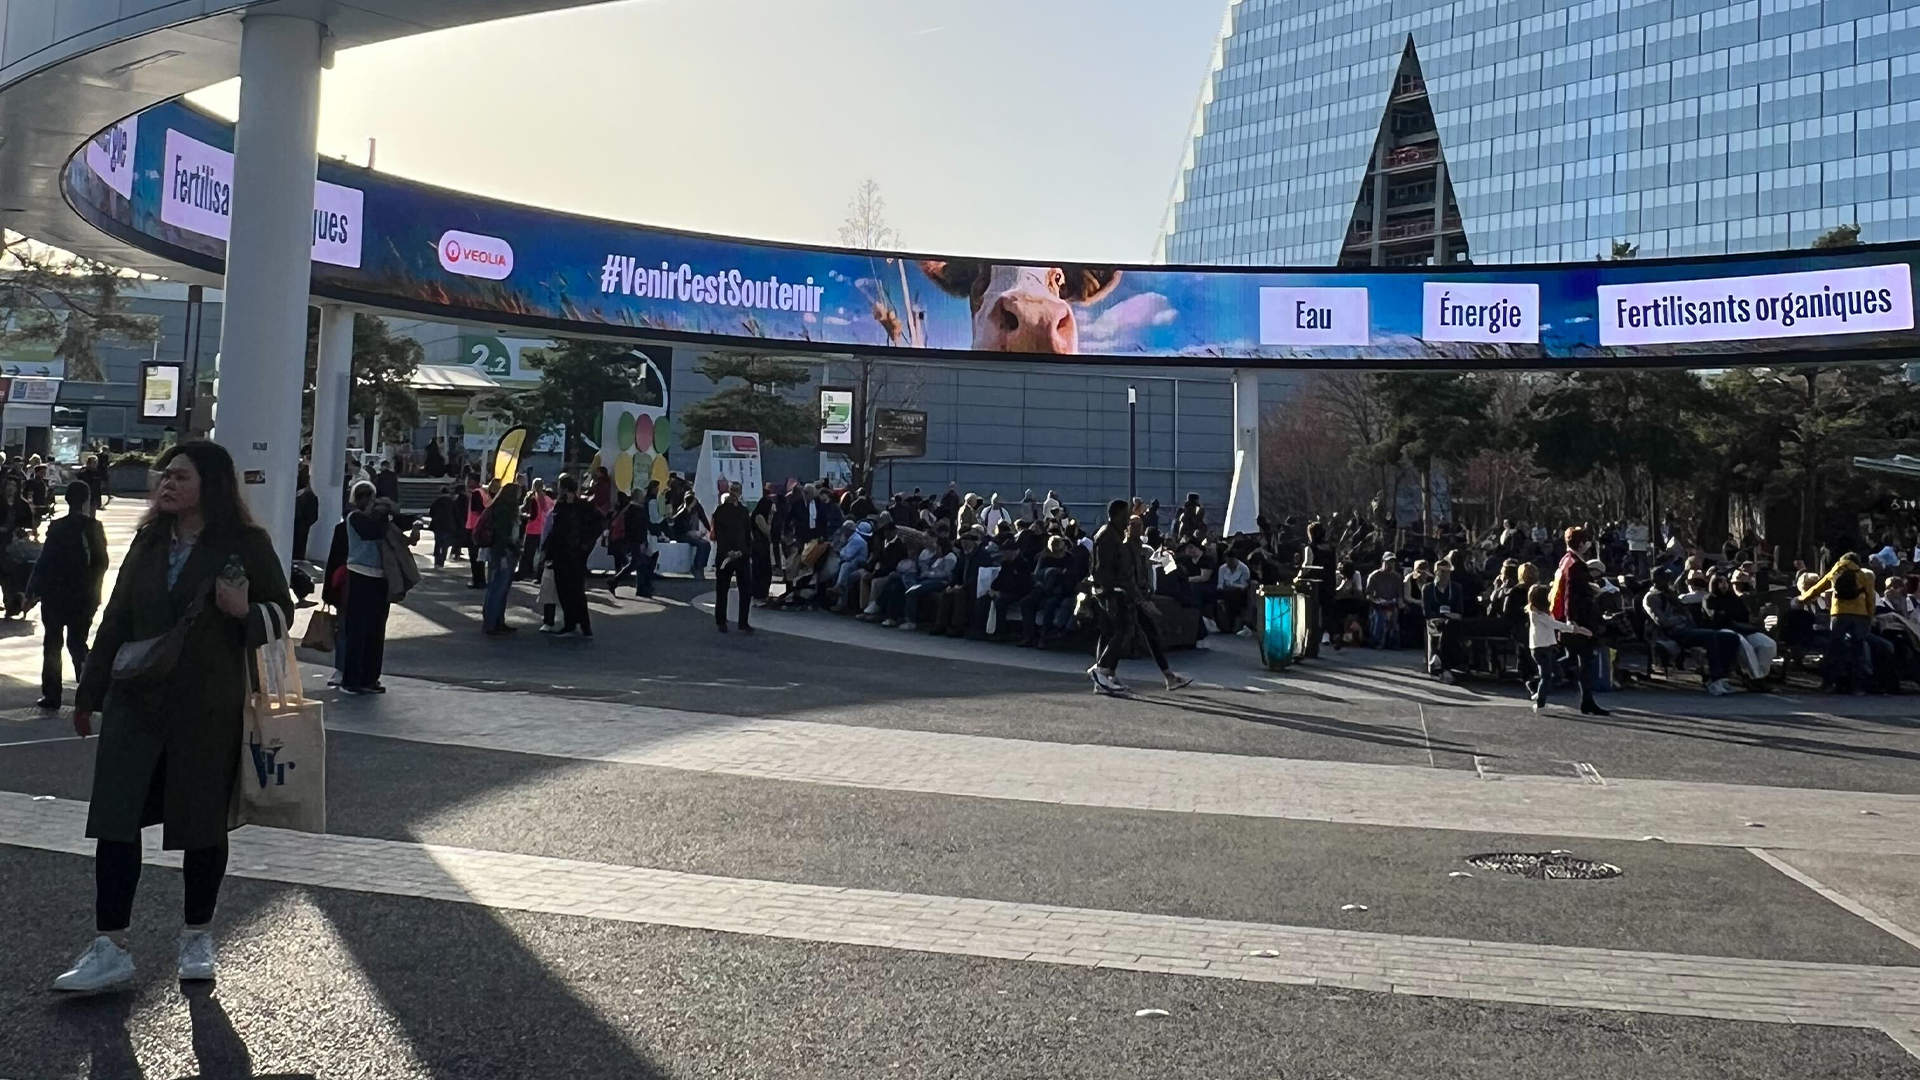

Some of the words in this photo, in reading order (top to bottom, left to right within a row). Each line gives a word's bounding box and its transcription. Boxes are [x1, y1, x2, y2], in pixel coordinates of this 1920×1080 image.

[173, 154, 230, 216] Fertilisa
[463, 247, 507, 267] VEOLIA
[600, 253, 825, 313] #VenirCestSoutenir
[1295, 300, 1333, 330] Eau
[1439, 291, 1523, 334] Énergie
[1616, 294, 1751, 328] Fertilisants
[1755, 285, 1893, 327] organiques
